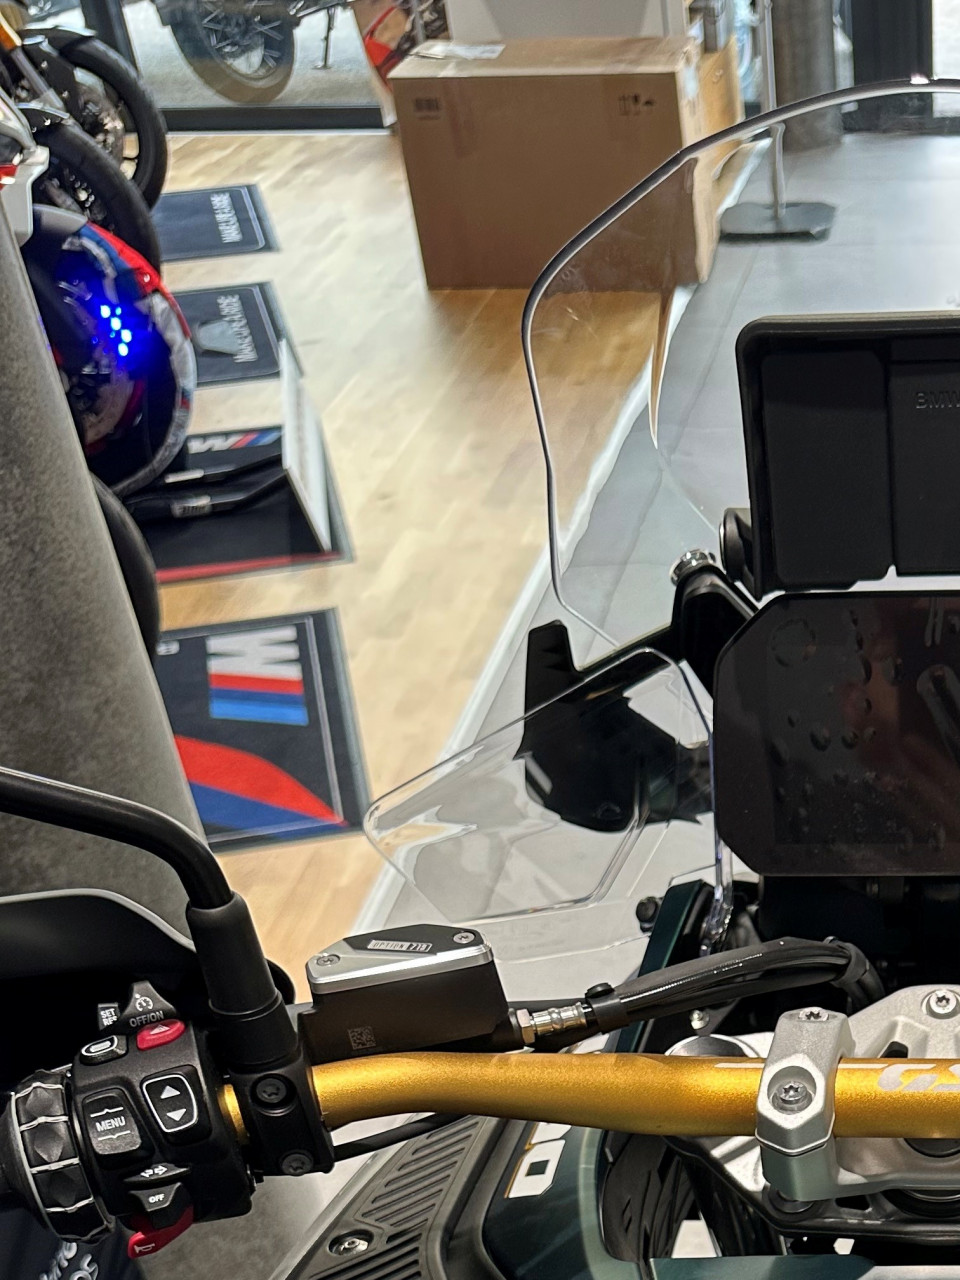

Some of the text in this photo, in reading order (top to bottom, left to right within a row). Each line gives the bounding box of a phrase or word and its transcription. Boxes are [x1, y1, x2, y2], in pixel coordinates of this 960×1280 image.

[373, 941, 405, 949] OPTION
[100, 1008, 116, 1019] SET
[129, 1010, 164, 1027] OFF/ON
[95, 1116, 126, 1132] MENU
[149, 1193, 165, 1204] OFF
